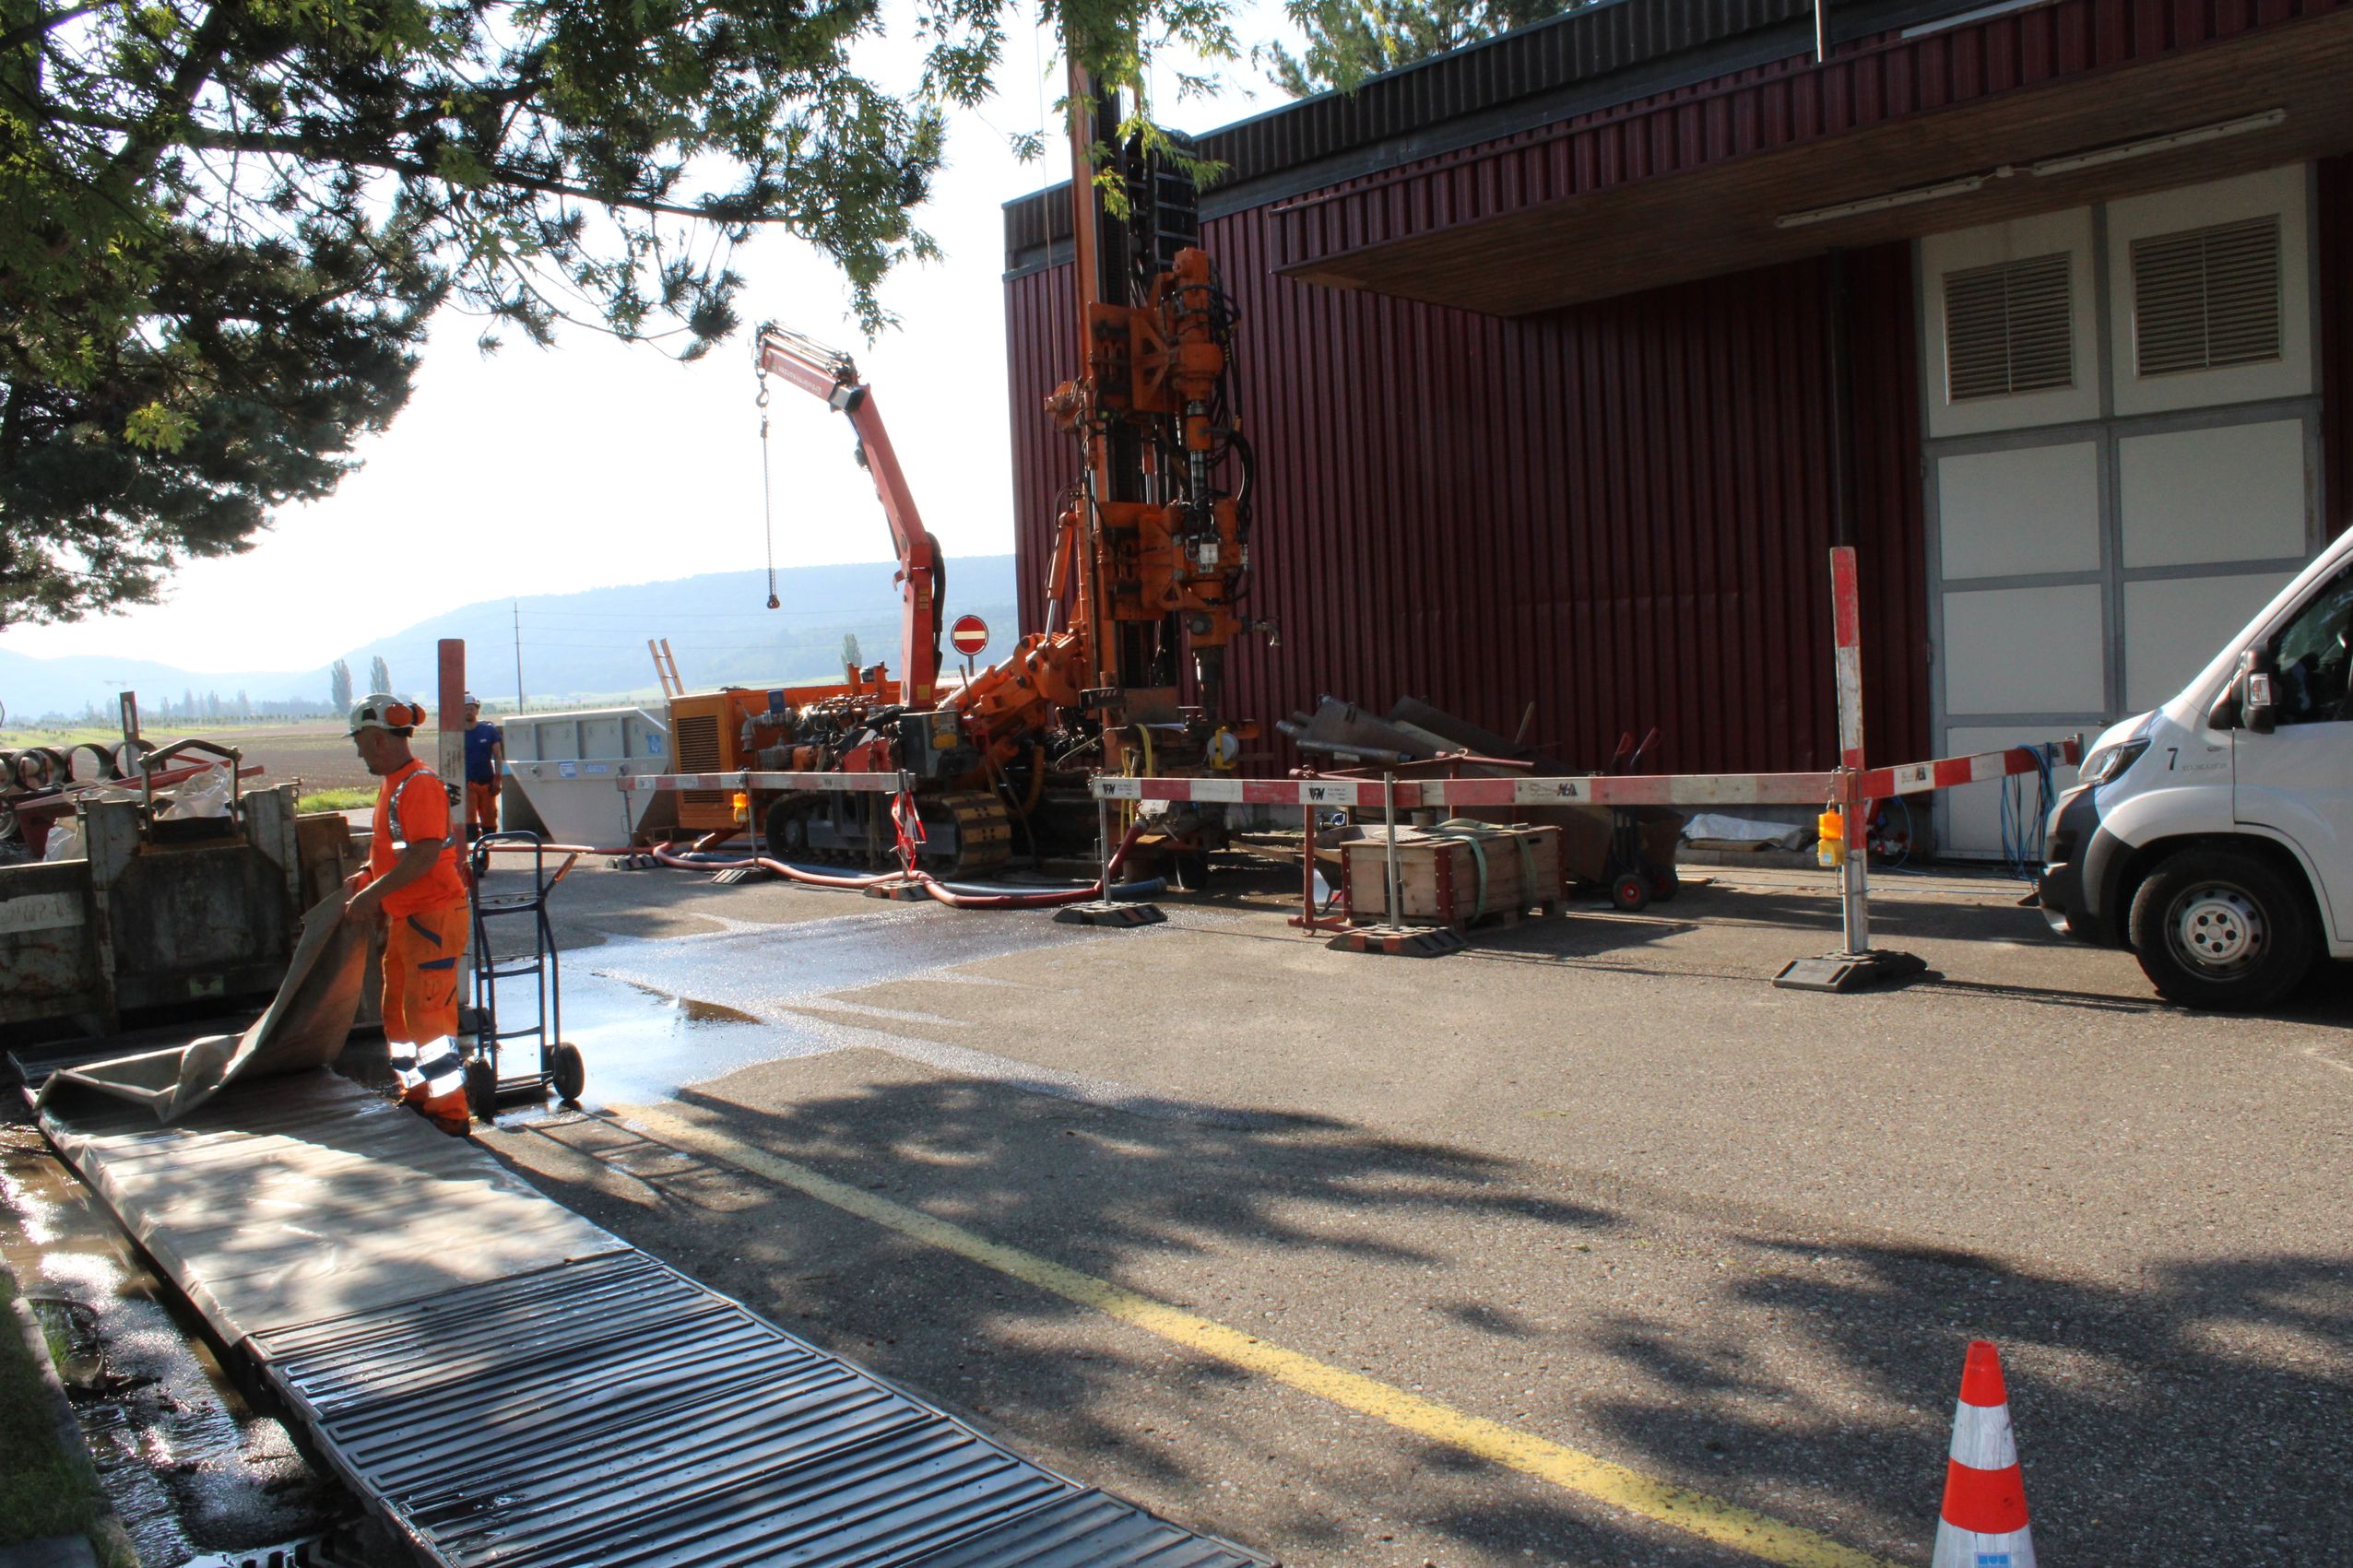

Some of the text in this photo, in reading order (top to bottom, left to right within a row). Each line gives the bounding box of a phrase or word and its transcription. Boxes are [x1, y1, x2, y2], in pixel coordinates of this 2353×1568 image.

[2168, 748, 2178, 771] 7
[1103, 784, 1116, 795] VFM
[1308, 787, 1325, 800] VFM
